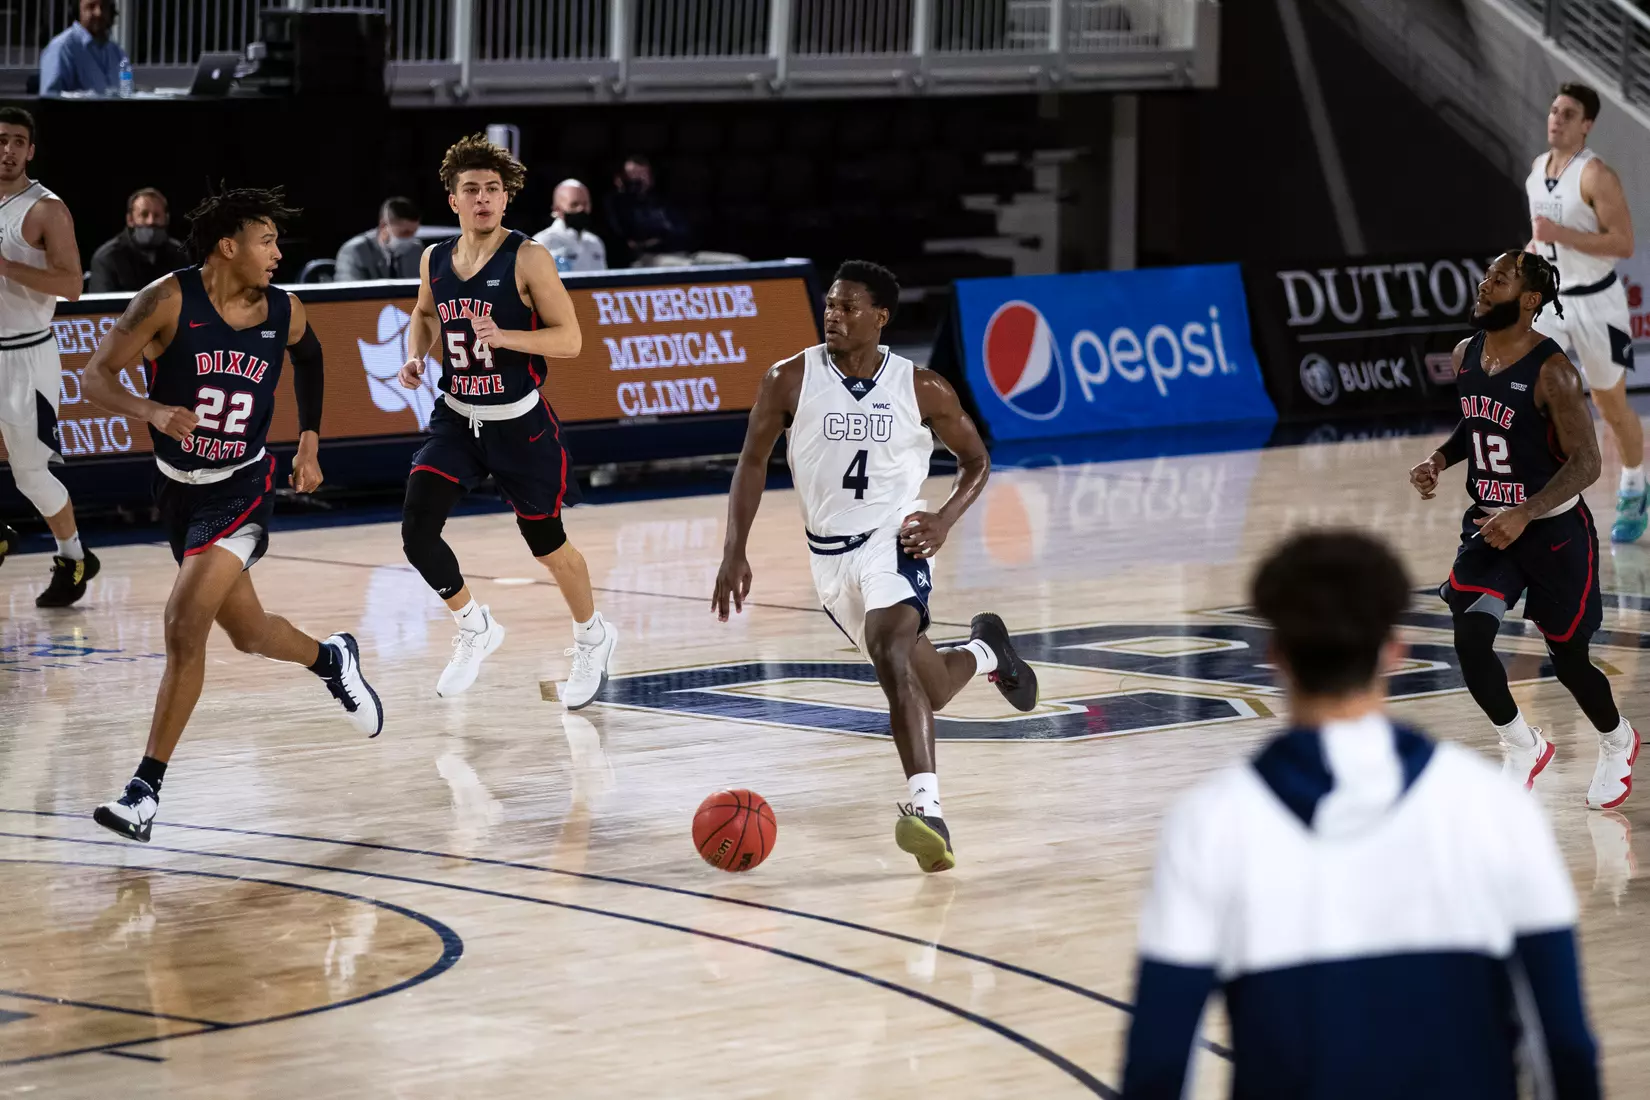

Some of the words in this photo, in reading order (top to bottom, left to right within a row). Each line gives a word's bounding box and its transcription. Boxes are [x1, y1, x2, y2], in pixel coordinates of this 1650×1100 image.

[438, 298, 493, 324] DIXIE
[592, 285, 758, 325] RIVERSIDE
[195, 350, 269, 384] DIXIE
[445, 330, 495, 371] 54
[603, 329, 747, 371] MEDICAL
[1070, 304, 1229, 402] pepsi
[450, 374, 505, 396] STATE
[1337, 357, 1412, 392] BUICK
[194, 384, 255, 436] 22
[616, 376, 720, 417] CLINIC
[871, 402, 891, 410] WAC
[1460, 395, 1515, 430] DIXIE
[57, 416, 132, 456] INIC
[181, 432, 247, 460] STATE
[823, 412, 893, 443] CBU
[1471, 429, 1513, 475] 12
[842, 449, 869, 500] 4
[1472, 478, 1527, 504] TATE
